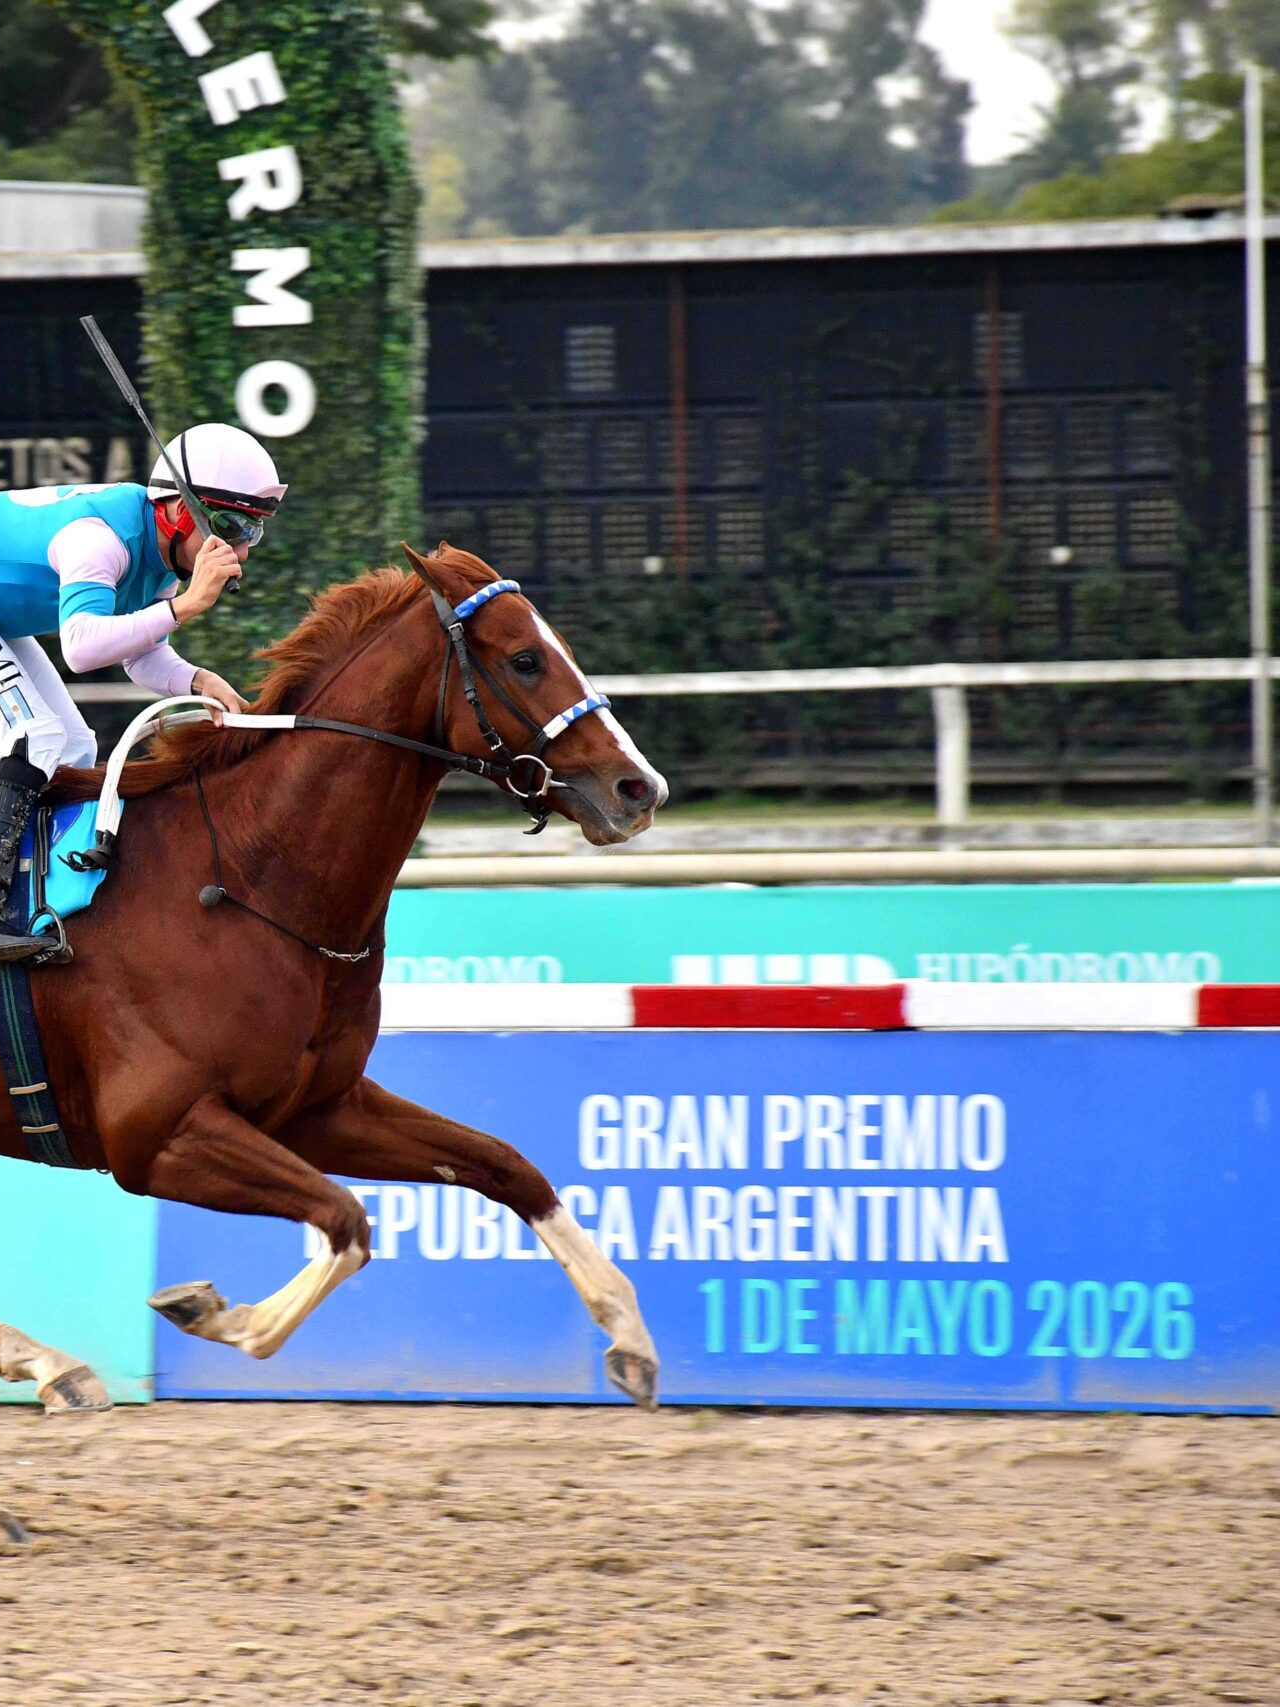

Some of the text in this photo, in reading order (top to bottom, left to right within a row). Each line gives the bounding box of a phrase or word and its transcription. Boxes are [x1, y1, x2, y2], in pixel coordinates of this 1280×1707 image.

[578, 1093, 1005, 1171] GRAN PREMIO
[648, 1185, 1008, 1263] ARGENTINA
[699, 1278, 1195, 1360] 1 DE MAYO 2026
